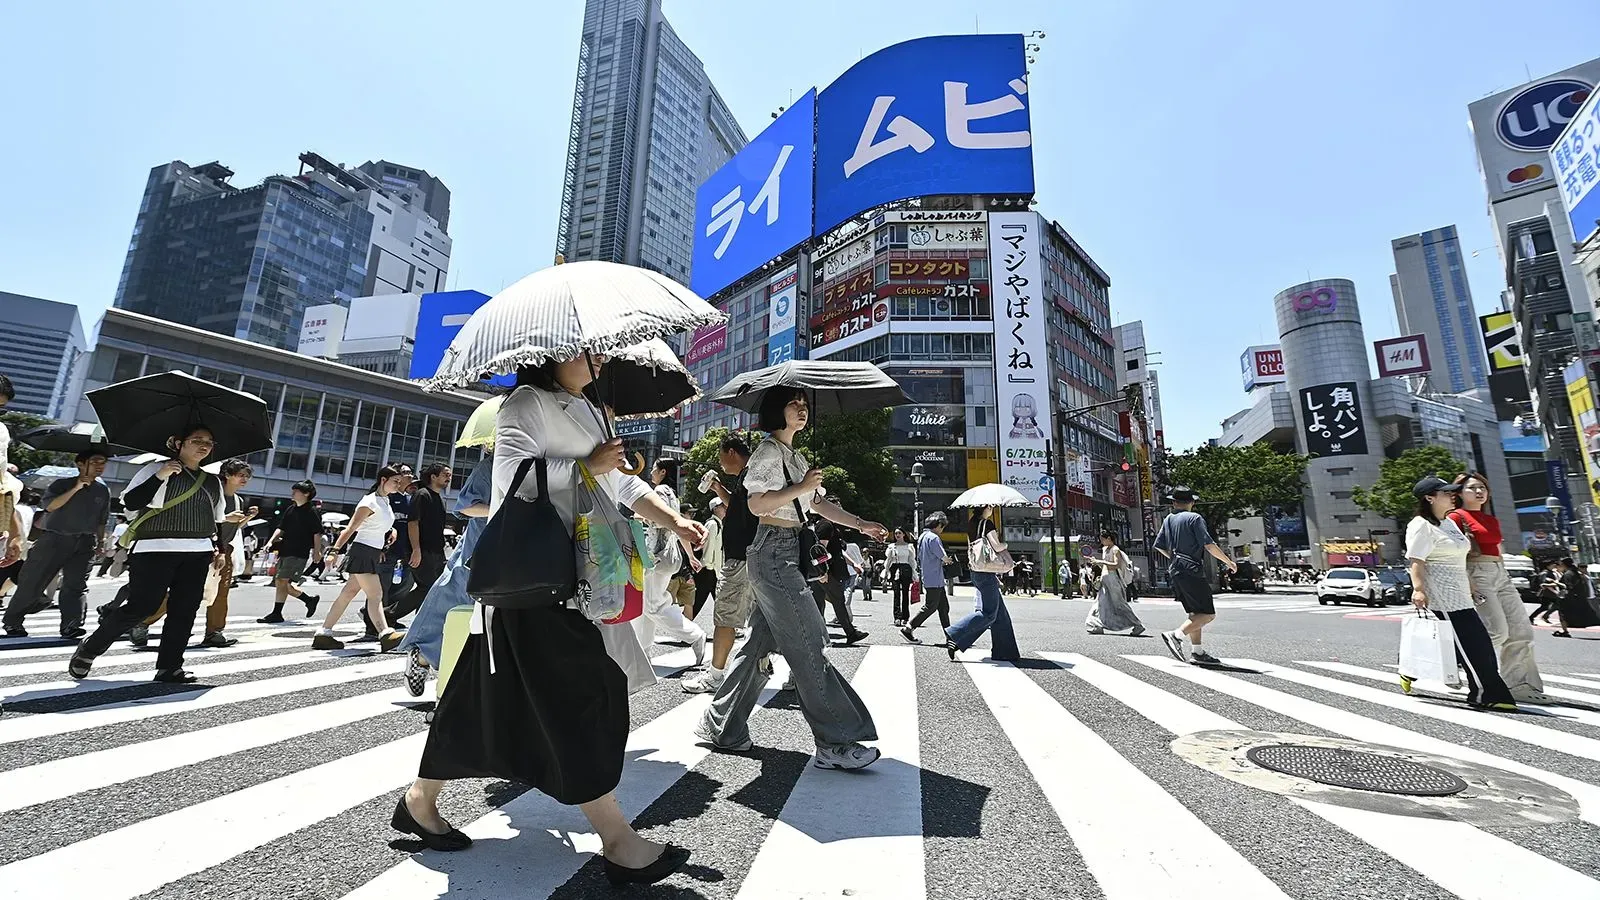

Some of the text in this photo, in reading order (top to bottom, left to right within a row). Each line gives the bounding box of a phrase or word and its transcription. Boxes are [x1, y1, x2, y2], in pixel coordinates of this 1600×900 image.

[706, 145, 794, 260] ライ
[900, 212, 982, 220] しゃぶしゃぶバイキング
[935, 227, 983, 242] しゃぶ葉
[841, 240, 871, 266] しゃぶ葉
[814, 267, 824, 279] 9F
[890, 262, 966, 275] コンタクト
[944, 285, 980, 297] ガスト
[851, 291, 877, 312] ガスト
[1001, 224, 1036, 383] 『マジやばくね』
[812, 332, 824, 345] 7F
[839, 314, 870, 339] ガスト
[1258, 353, 1281, 363] UNI
[1389, 347, 1415, 364] H&M
[1260, 363, 1285, 375] QLO
[909, 413, 947, 425] Ushi8
[1329, 387, 1359, 439] 角パン
